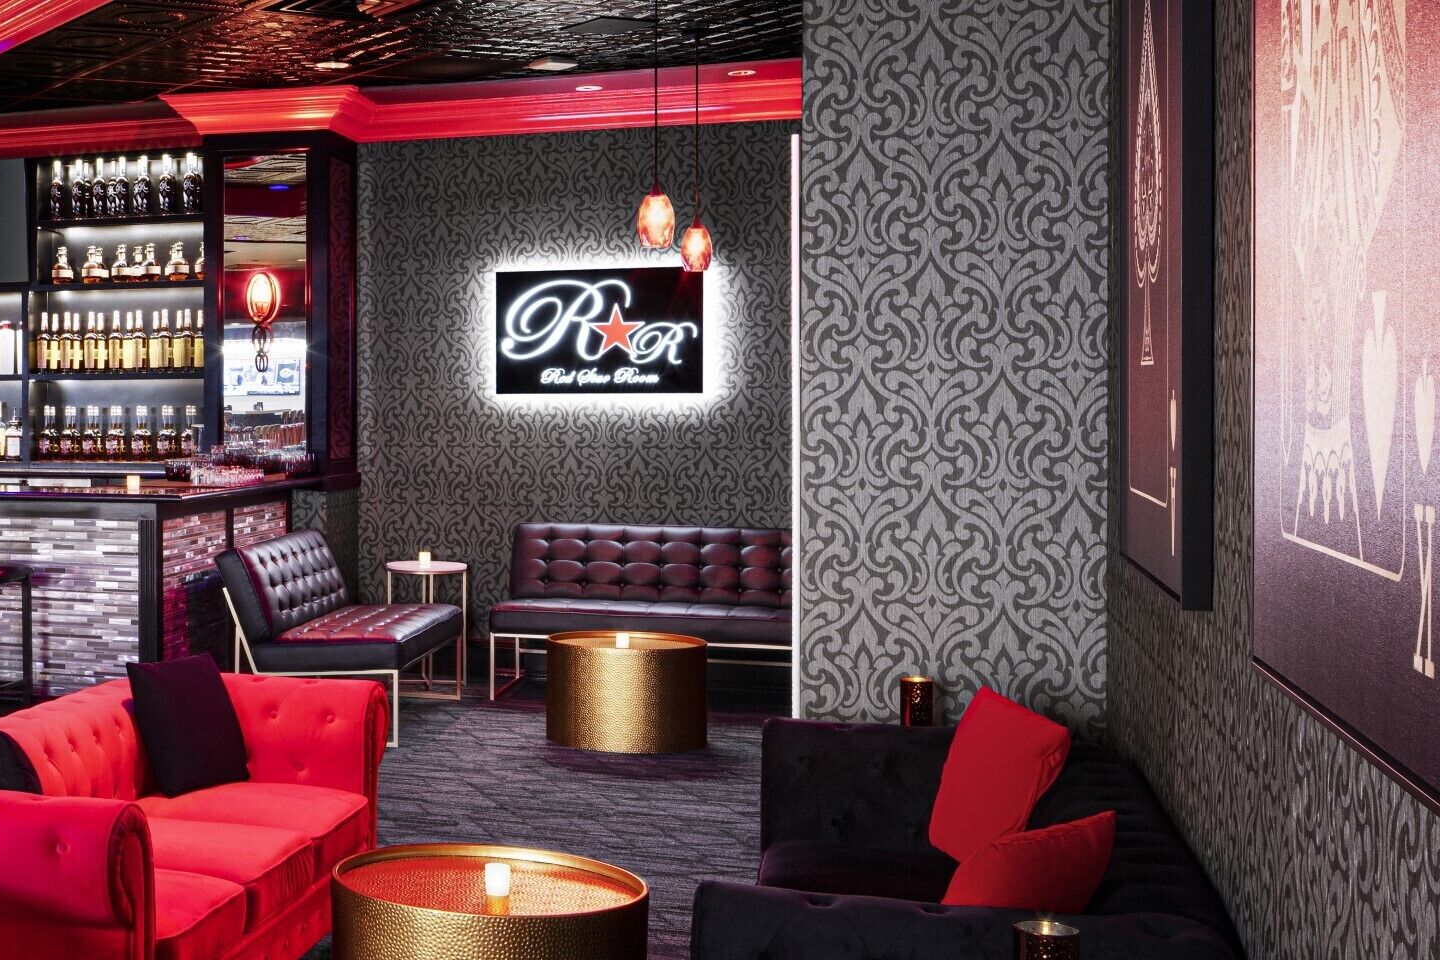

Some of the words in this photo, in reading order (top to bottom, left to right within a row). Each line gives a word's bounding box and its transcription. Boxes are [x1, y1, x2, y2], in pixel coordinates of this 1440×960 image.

[540, 368, 576, 384] Red
[577, 368, 611, 386] Star
[613, 367, 659, 384] Room
